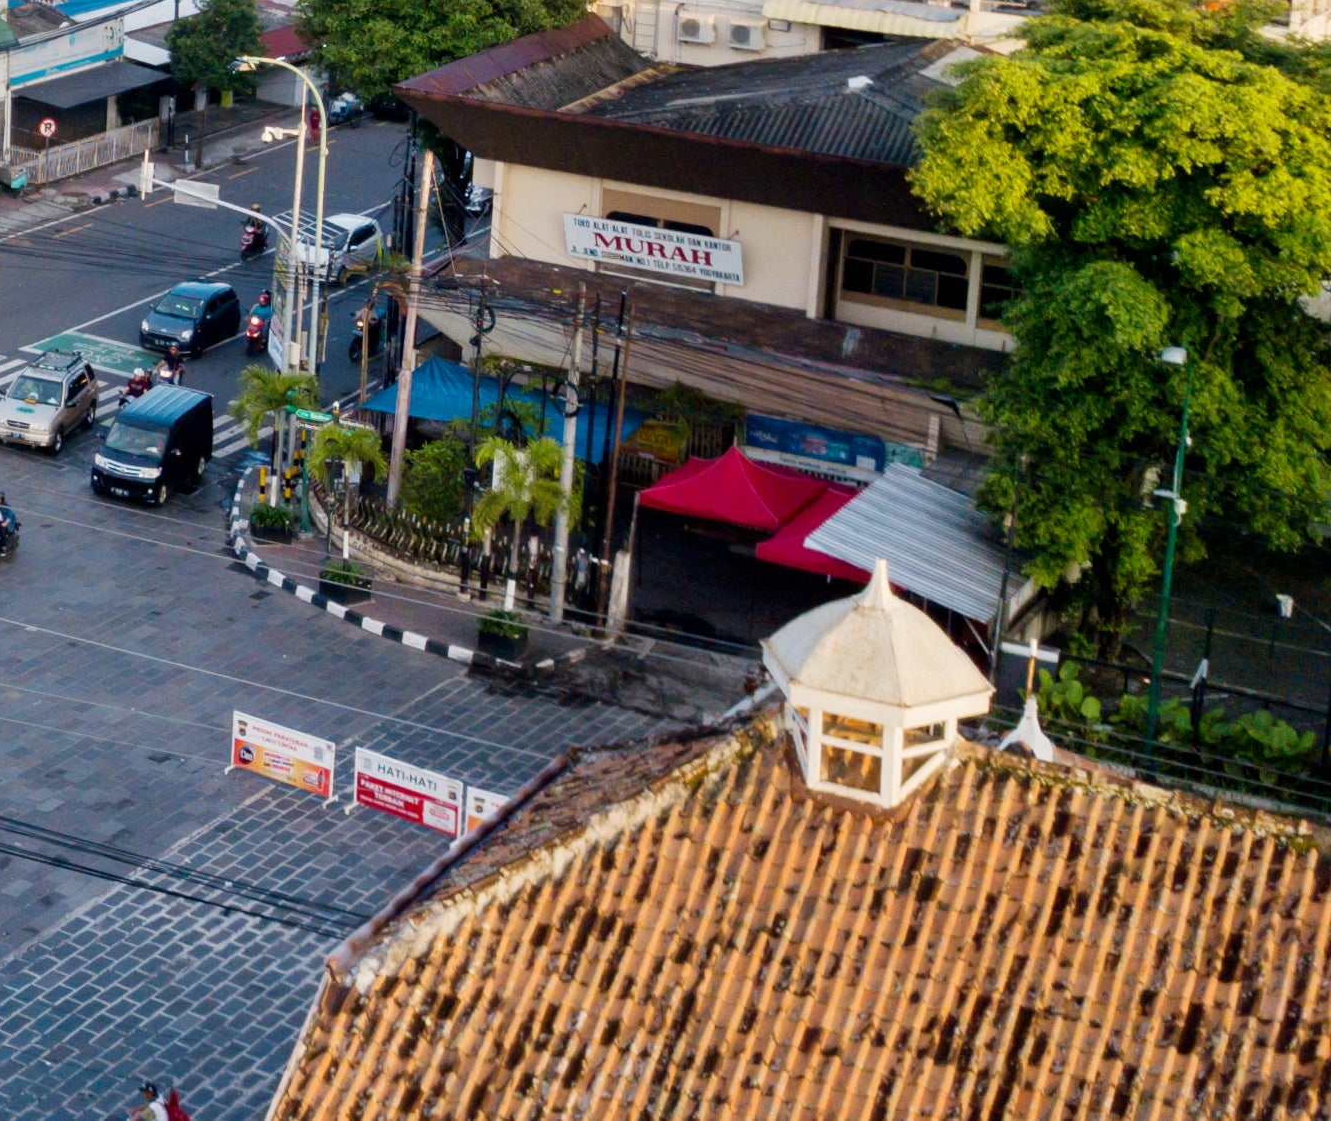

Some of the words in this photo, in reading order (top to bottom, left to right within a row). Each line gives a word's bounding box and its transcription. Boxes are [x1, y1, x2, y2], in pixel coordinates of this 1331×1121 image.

[573, 218, 590, 228] TOKO
[632, 227, 652, 239] TULIS
[654, 232, 685, 245] SEKOLAH
[687, 237, 702, 248] DAN
[704, 241, 732, 252] KANTOR
[593, 231, 713, 267] MURAH
[699, 268, 740, 282] YOGYAKARTA
[377, 762, 438, 791] HATI-HATI
